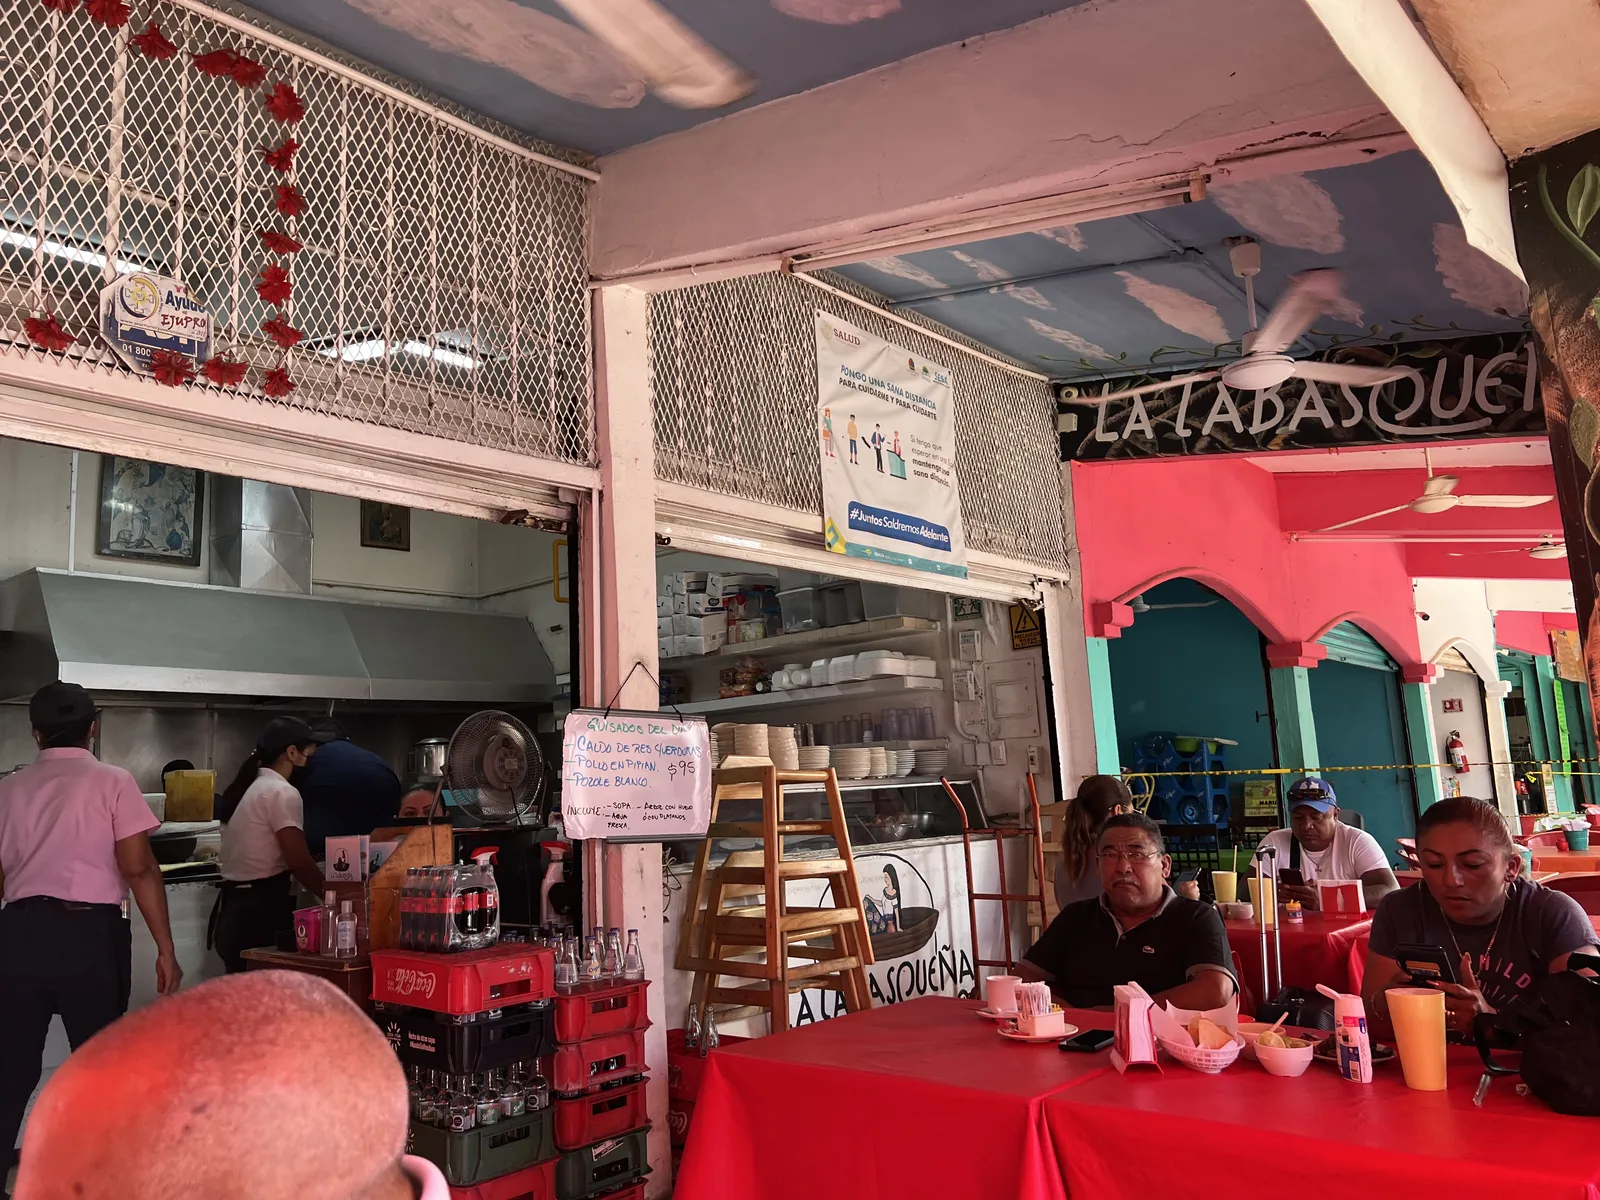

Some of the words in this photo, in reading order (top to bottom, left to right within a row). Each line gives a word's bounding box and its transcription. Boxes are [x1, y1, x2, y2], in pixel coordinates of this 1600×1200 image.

[833, 328, 861, 346] SALUD
[122, 343, 132, 353] 01
[840, 364, 867, 383] PONGO
[868, 375, 886, 390] UNA
[886, 382, 904, 397] SANA
[905, 390, 937, 410] DISTANCIA
[838, 377, 857, 391] PARA
[858, 383, 890, 402] CUIDARME
[890, 395, 895, 404] Y
[895, 397, 912, 411] PARA
[912, 403, 937, 421] CUIDARTE
[1094, 380, 1153, 442] LA
[913, 469, 929, 479] sana
[849, 507, 949, 543] #JuntosSaldremosAdelante
[587, 718, 643, 734] GUISADOS
[649, 723, 667, 735] DEL
[577, 735, 612, 754] CALDO
[617, 743, 631, 753] DE
[632, 743, 651, 755] RES
[575, 754, 608, 772] POLLO
[611, 759, 624, 771] EN
[668, 760, 696, 781] $95
[573, 772, 610, 788] POZOLE
[612, 812, 627, 820] AGUA
[394, 967, 436, 999] Coca-Cola
